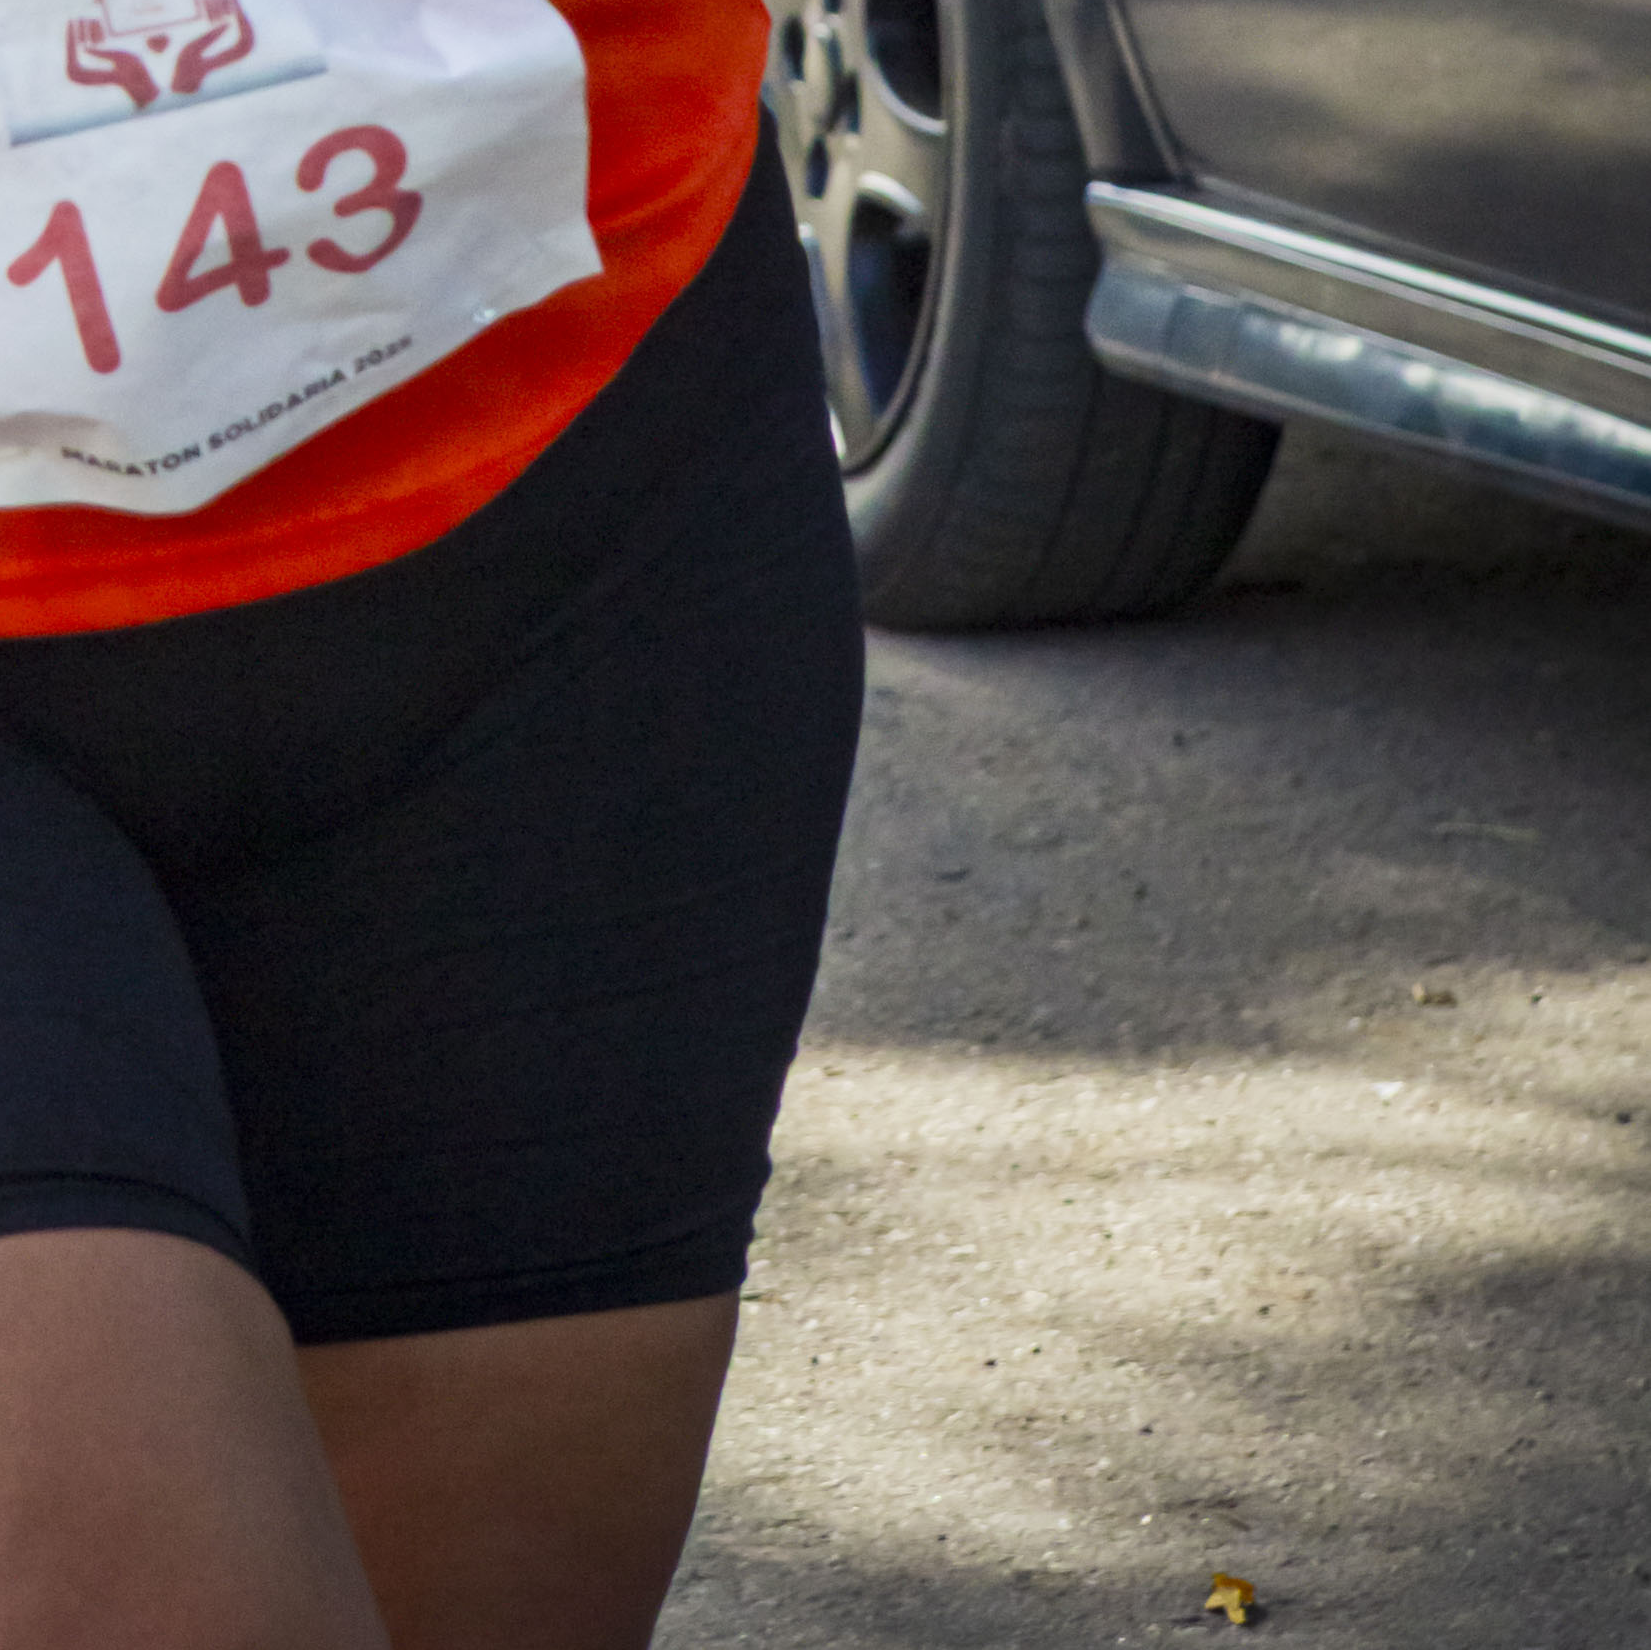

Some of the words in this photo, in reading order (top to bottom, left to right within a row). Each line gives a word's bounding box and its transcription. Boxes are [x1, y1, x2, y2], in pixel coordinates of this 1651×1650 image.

[7, 125, 424, 375] 143
[61, 443, 202, 477] MARATON
[207, 369, 347, 451] SOLIDARIA
